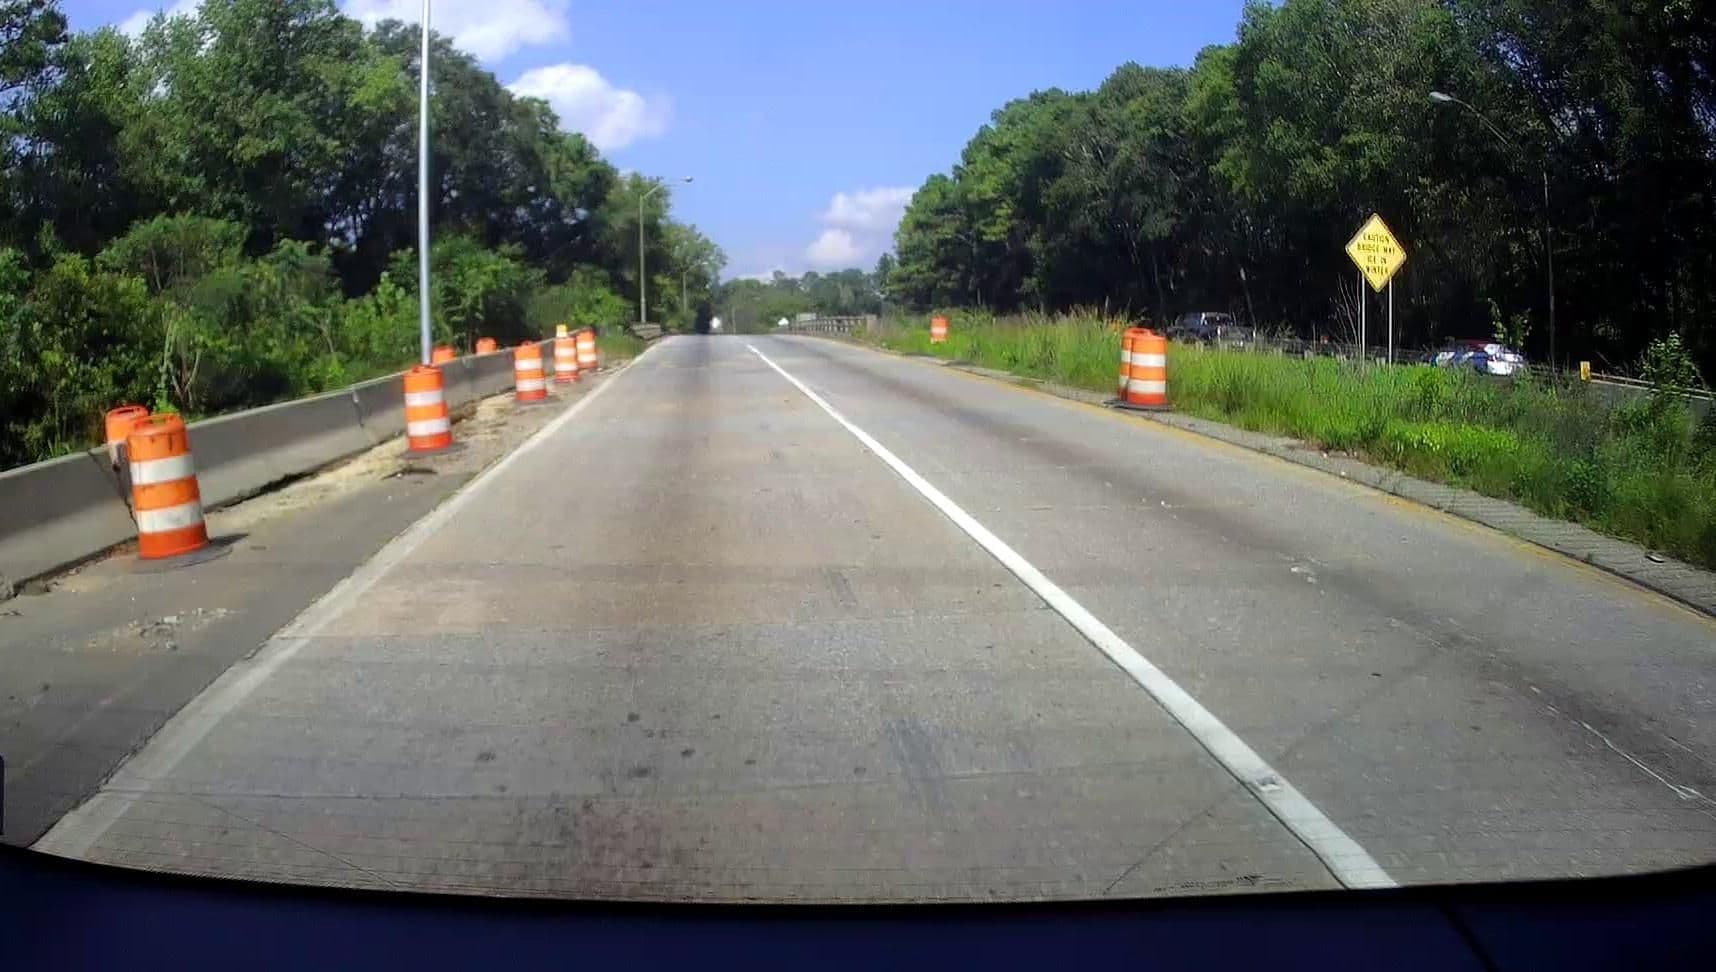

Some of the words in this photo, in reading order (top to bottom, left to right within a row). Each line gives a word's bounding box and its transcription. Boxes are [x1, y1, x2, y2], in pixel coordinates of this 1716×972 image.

[1363, 232, 1390, 244] CAUTION
[1357, 242, 1379, 253] BRIDGE
[1383, 246, 1395, 255] MAY
[1367, 255, 1376, 264] ICE
[1380, 257, 1387, 265] IN
[1365, 265, 1389, 275] WINTER
